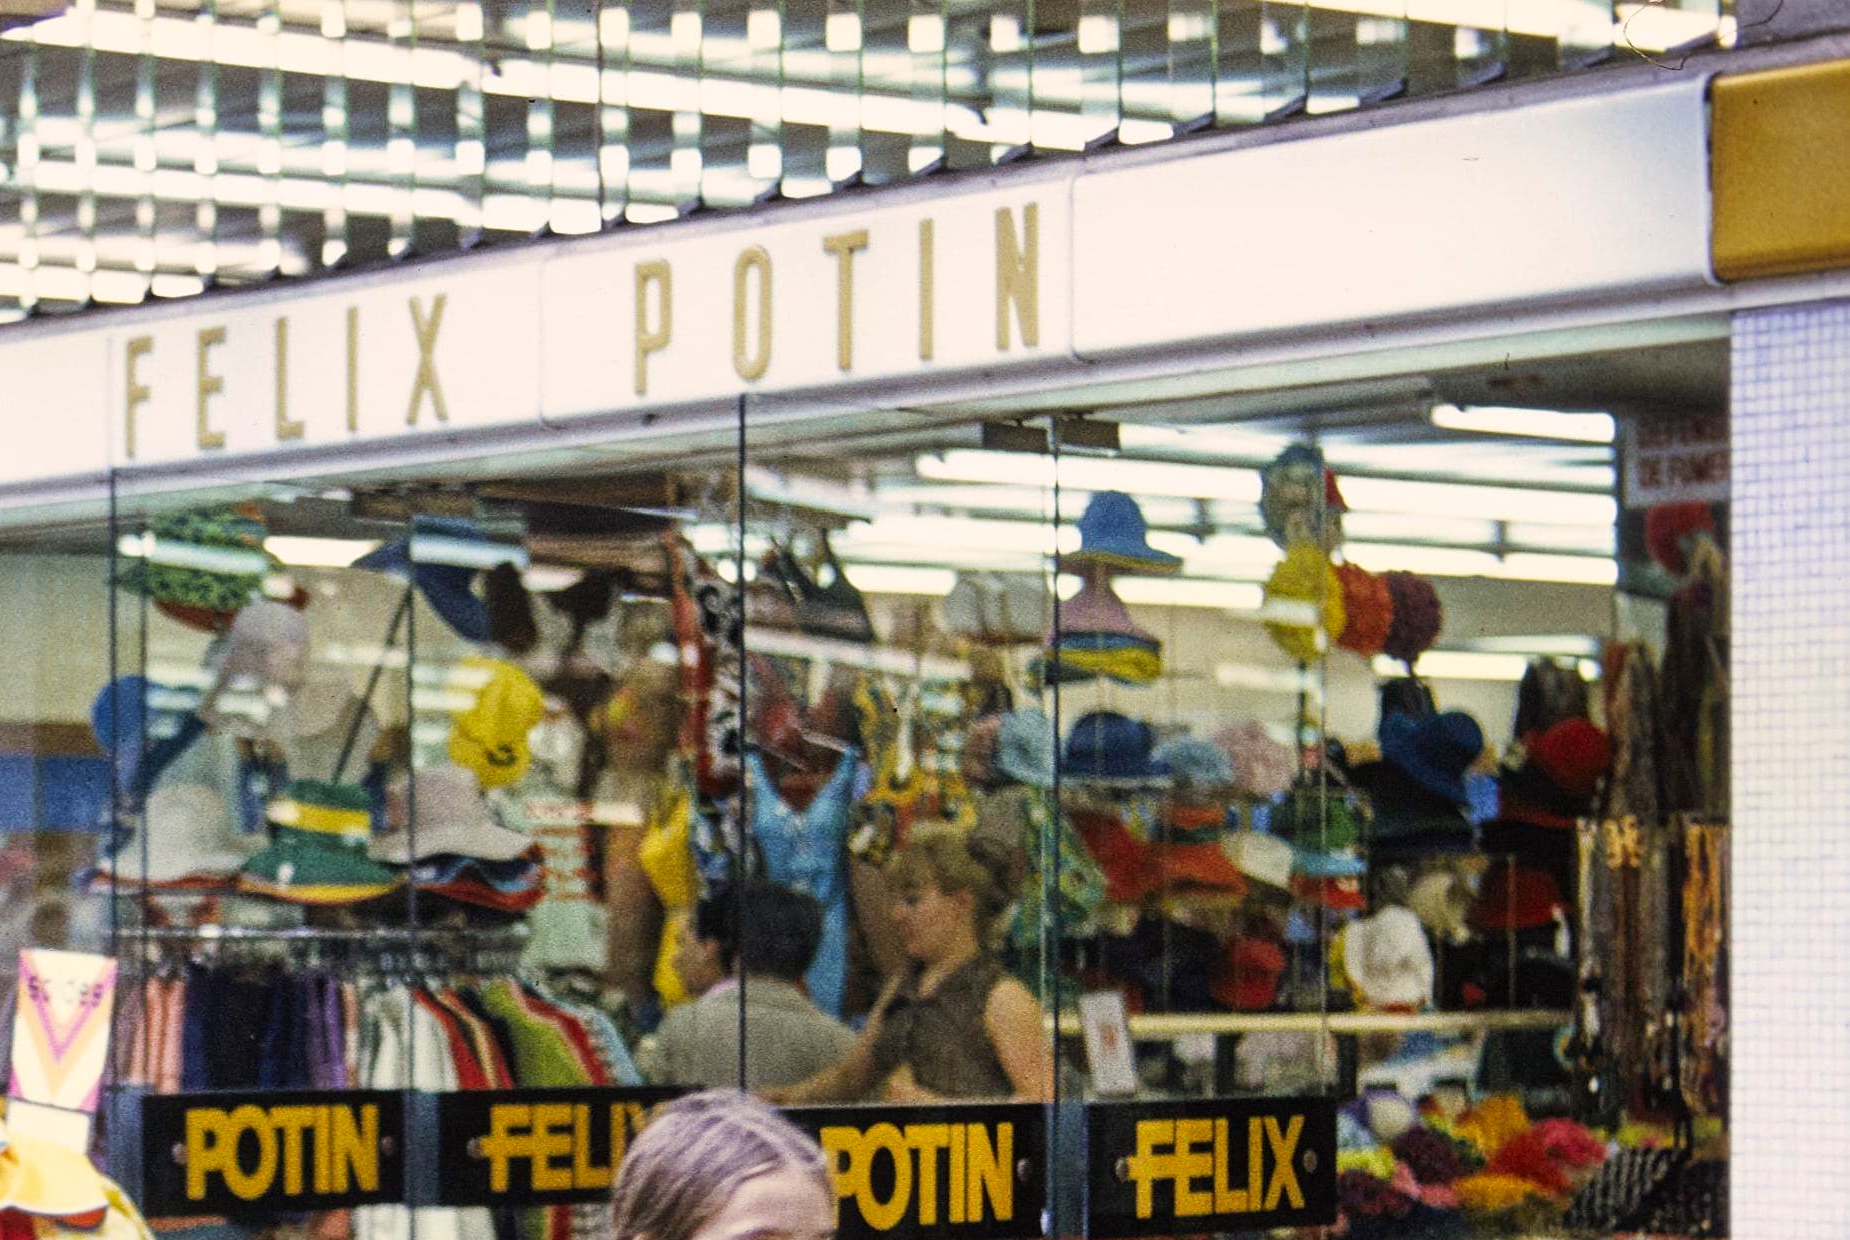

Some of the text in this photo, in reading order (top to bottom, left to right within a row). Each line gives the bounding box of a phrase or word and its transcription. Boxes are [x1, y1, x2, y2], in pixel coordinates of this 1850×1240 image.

[124, 202, 1040, 458] FELIX POTIN
[185, 1103, 379, 1199] POTIN
[820, 1122, 1014, 1231] POTIN
[1127, 1114, 1304, 1219] FELIX
